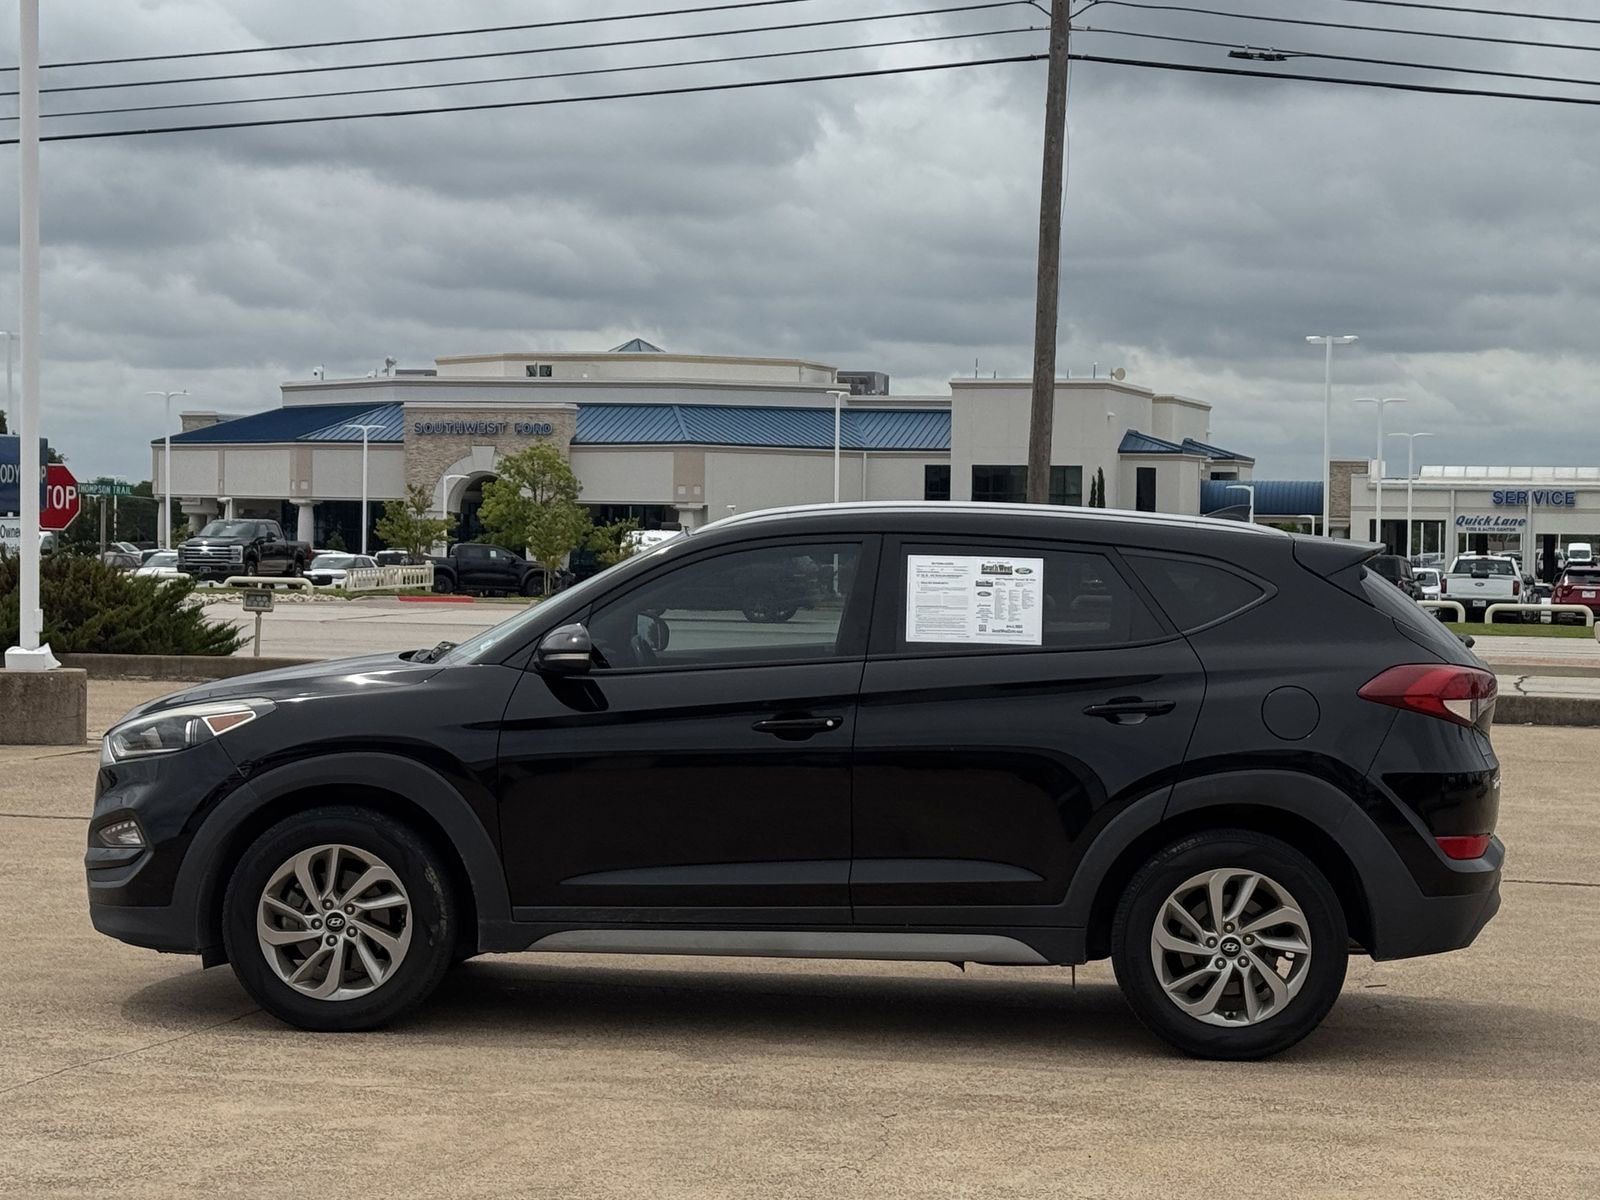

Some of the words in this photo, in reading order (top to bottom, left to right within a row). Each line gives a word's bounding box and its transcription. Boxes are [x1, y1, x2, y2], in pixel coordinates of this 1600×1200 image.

[414, 422, 505, 434] SOUTHWEST
[515, 422, 553, 434] FORD
[0, 464, 20, 483] ODY
[77, 484, 111, 494] THOMPSON
[112, 485, 132, 495] TRAIL
[46, 485, 77, 510] TOP
[1492, 490, 1576, 506] SERVICE
[1456, 515, 1493, 527] Quick
[1493, 515, 1526, 527] Lane
[0, 524, 20, 538] Owne
